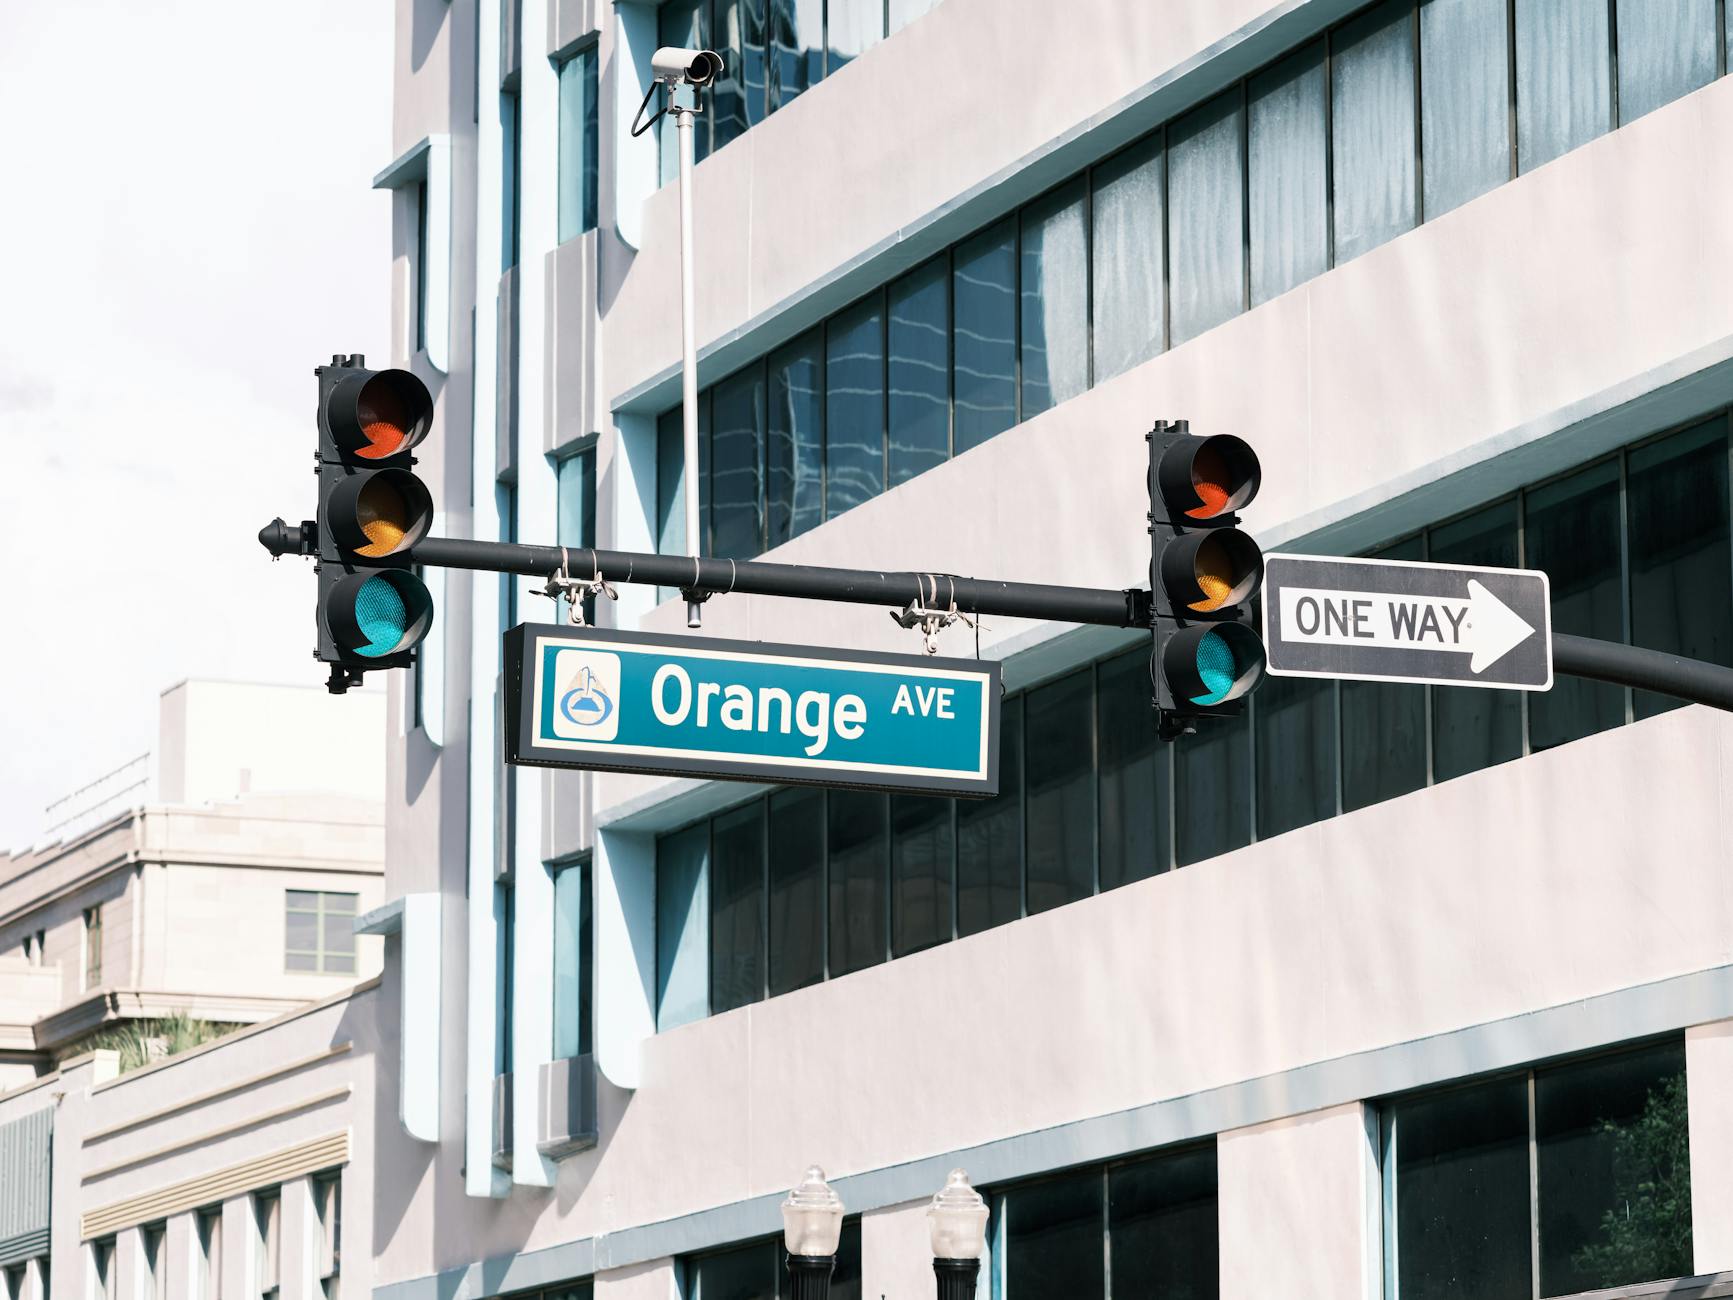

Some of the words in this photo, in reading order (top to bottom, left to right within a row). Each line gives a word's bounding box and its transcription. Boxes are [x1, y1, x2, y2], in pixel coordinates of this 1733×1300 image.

[1295, 596, 1375, 638] ONE
[1388, 602, 1468, 644] WAY
[651, 663, 867, 757] Orange
[891, 684, 955, 720] AVE
